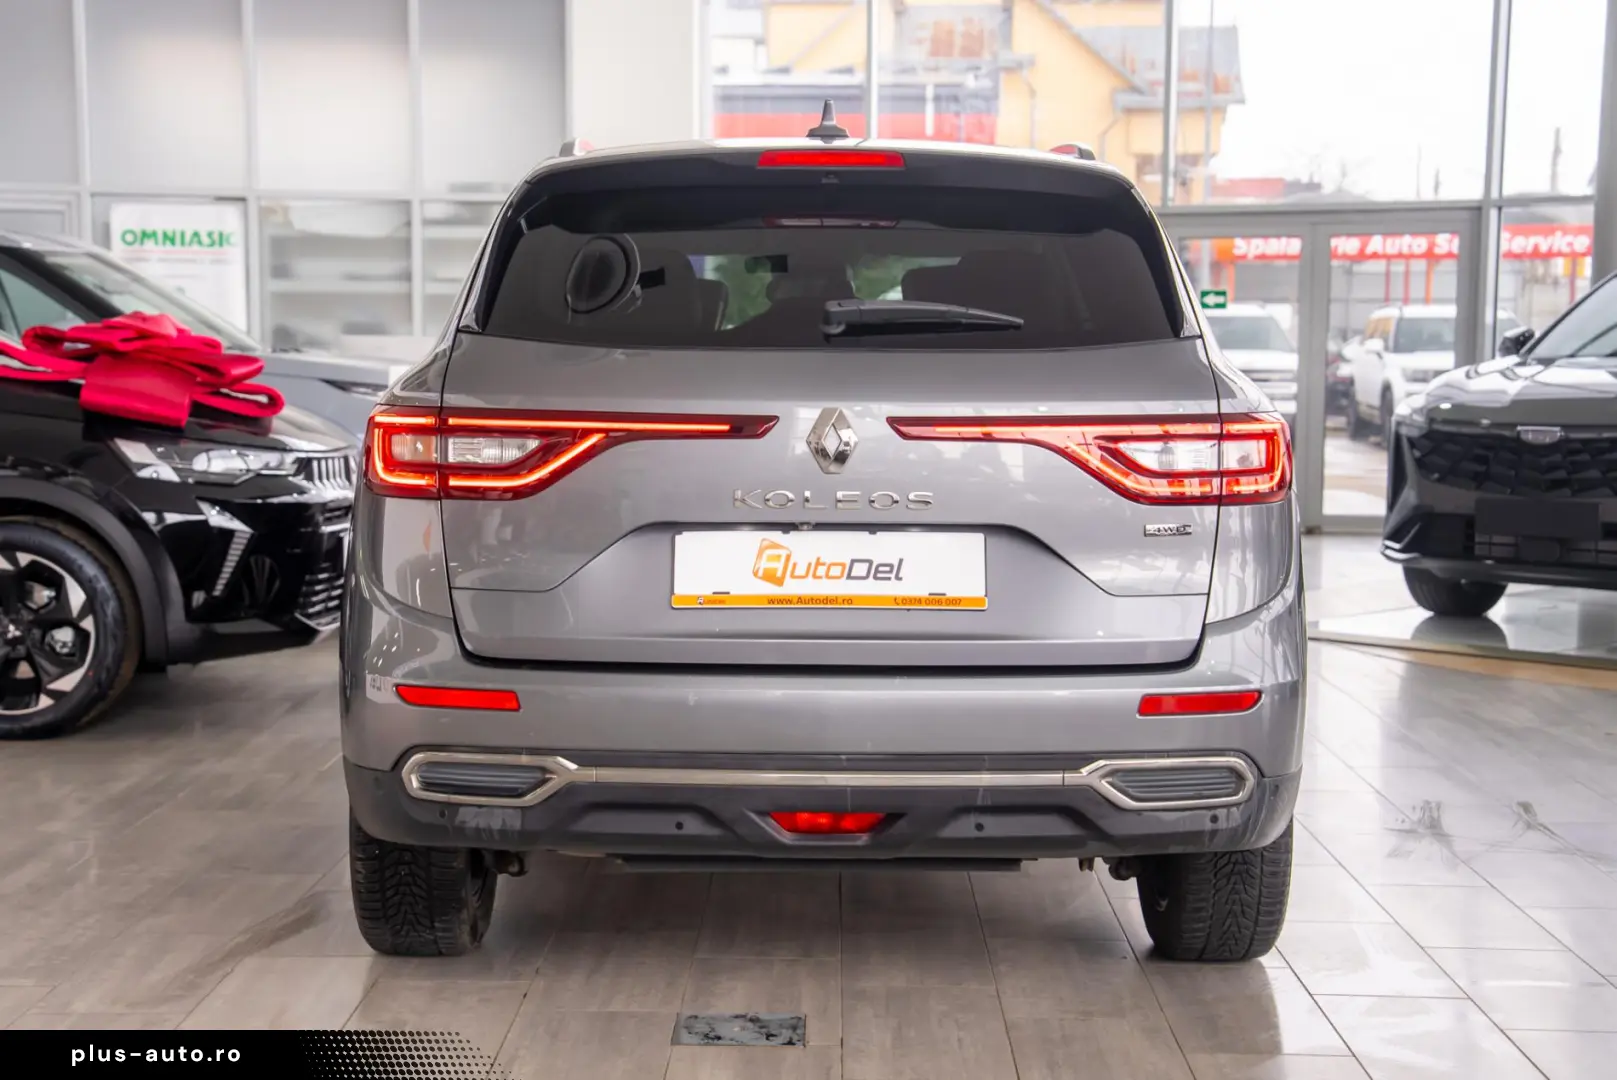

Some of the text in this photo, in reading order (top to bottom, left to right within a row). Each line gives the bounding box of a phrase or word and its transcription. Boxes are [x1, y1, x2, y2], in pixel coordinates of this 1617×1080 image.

[1365, 234, 1429, 255] Auto
[733, 489, 934, 510] KOLEOS
[752, 538, 904, 587] AutoDel
[767, 596, 853, 606] www.Autodel.ro
